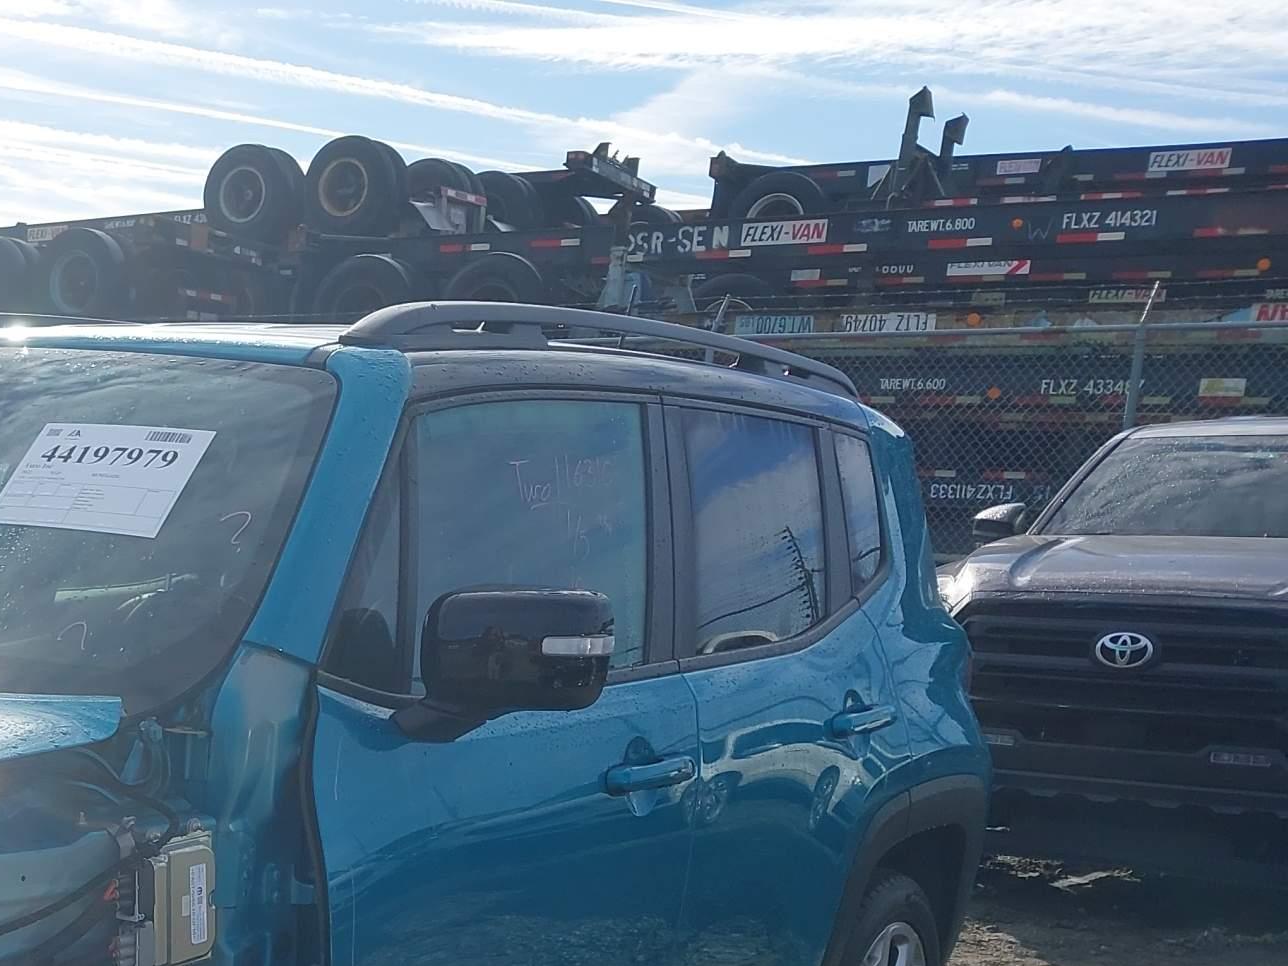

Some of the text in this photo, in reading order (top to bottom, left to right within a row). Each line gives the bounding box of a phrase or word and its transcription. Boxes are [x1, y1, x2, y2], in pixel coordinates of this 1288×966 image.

[1150, 151, 1229, 169] FLEXI-VAN
[1062, 209, 1157, 229] FLXZ 414321
[743, 222, 825, 242] FLEXI-VAN
[1040, 379, 1144, 395] FLXZ 4334
[40, 444, 179, 469] 44197979
